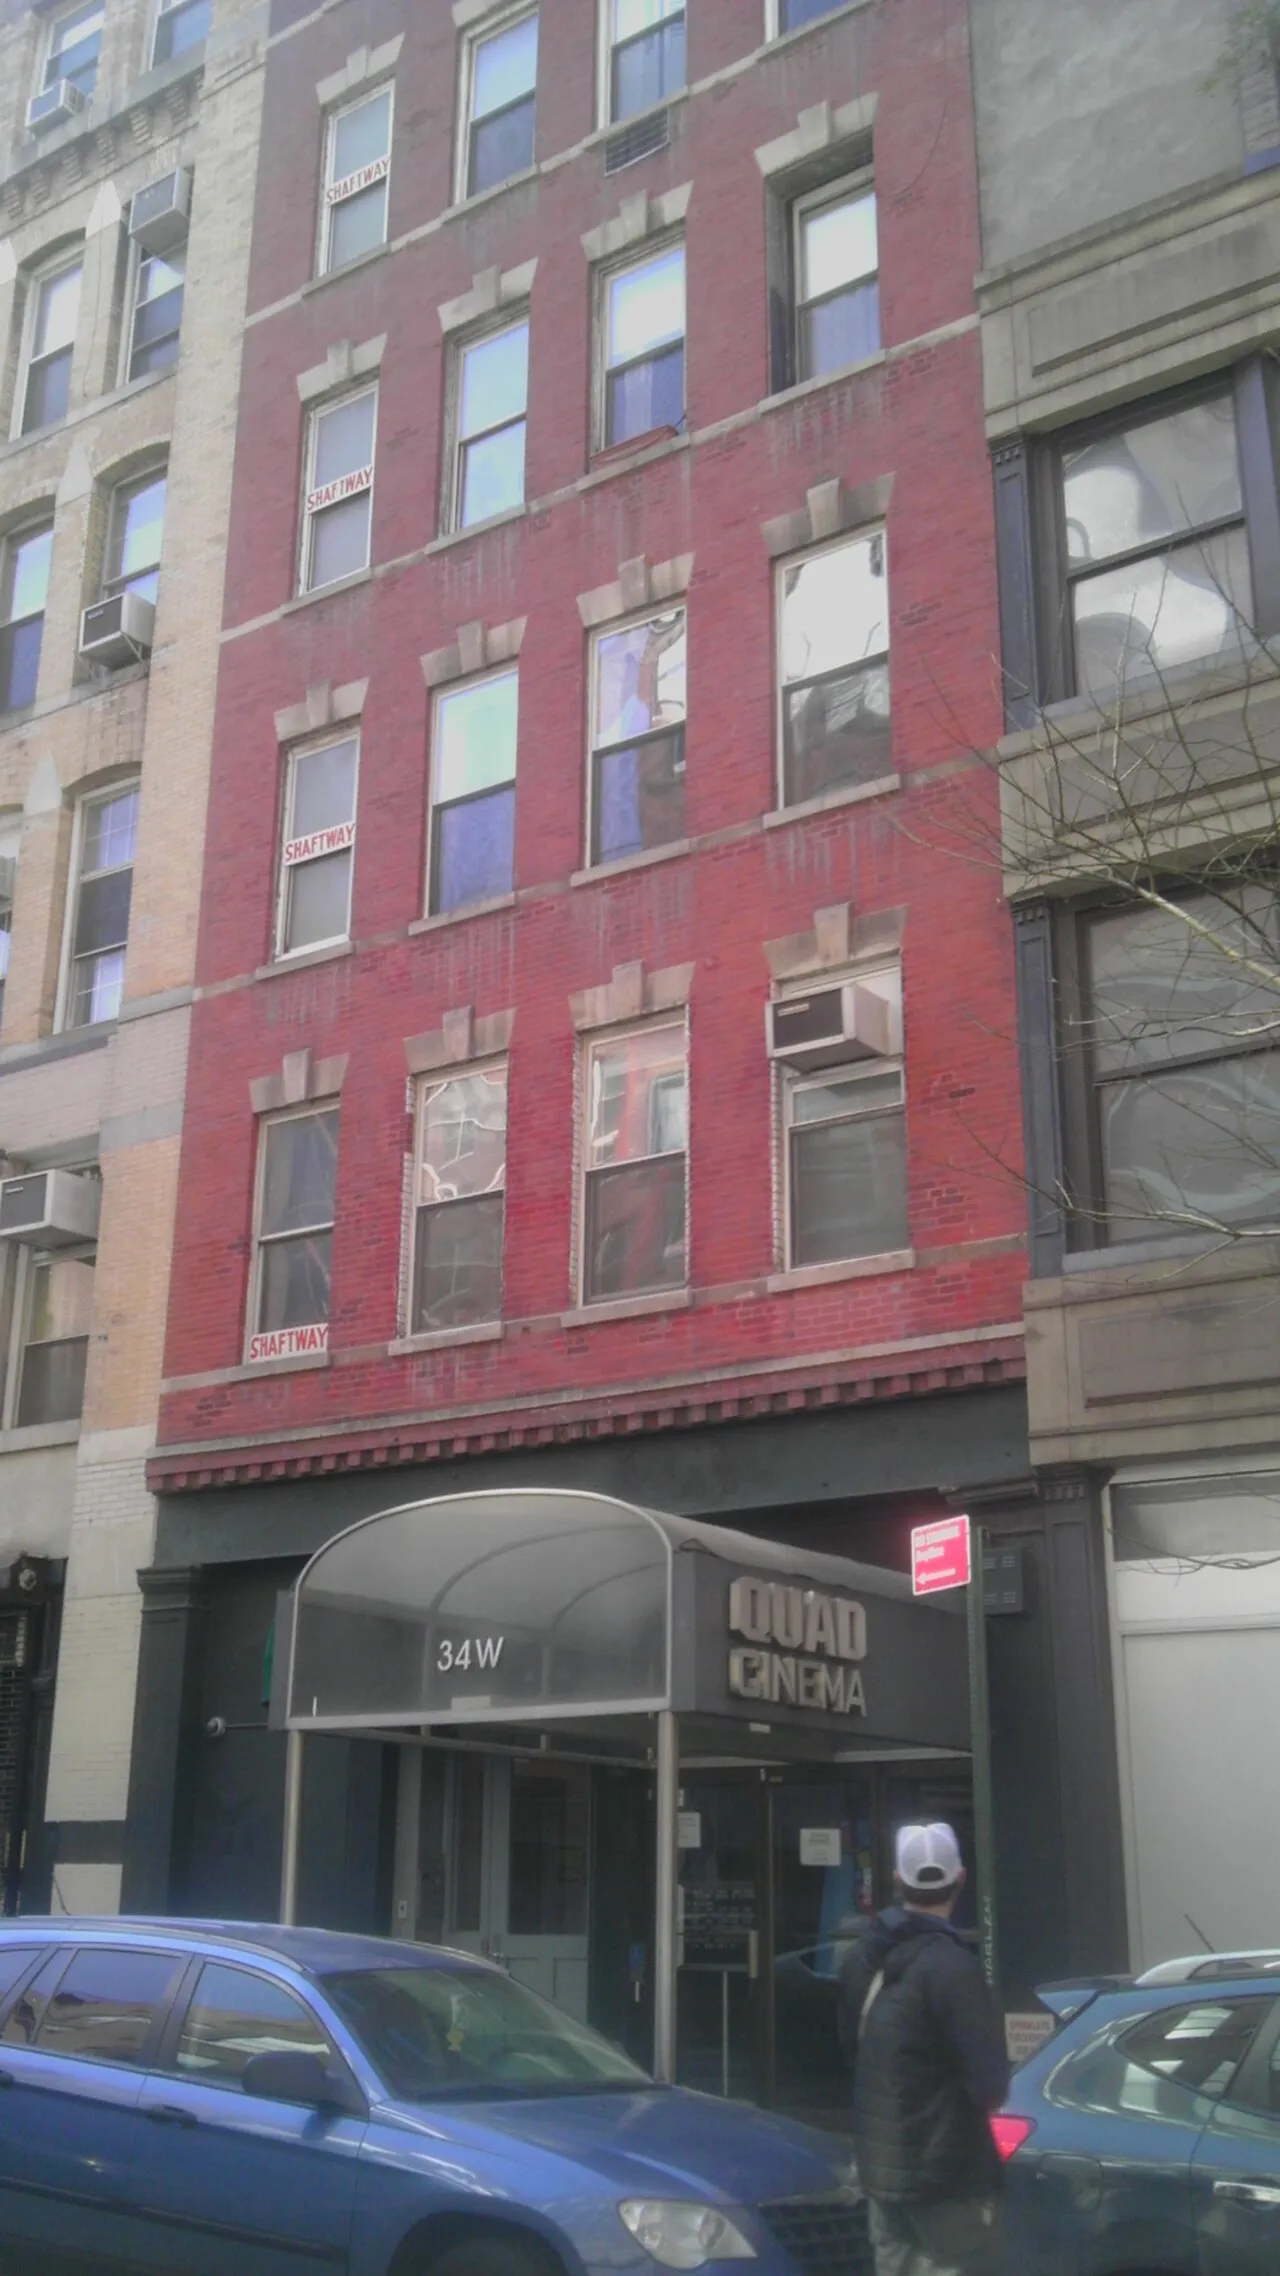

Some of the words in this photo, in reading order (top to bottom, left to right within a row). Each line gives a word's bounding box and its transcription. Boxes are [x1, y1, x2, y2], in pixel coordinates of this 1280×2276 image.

[325, 158, 390, 204] SHAFTWAY
[307, 465, 373, 511] SHAFTWAY
[285, 822, 356, 863] SHAFTWAY
[250, 1325, 329, 1359] SHAFTWAY
[729, 1576, 866, 1661] QUAD
[729, 1648, 867, 1717] CINEMA
